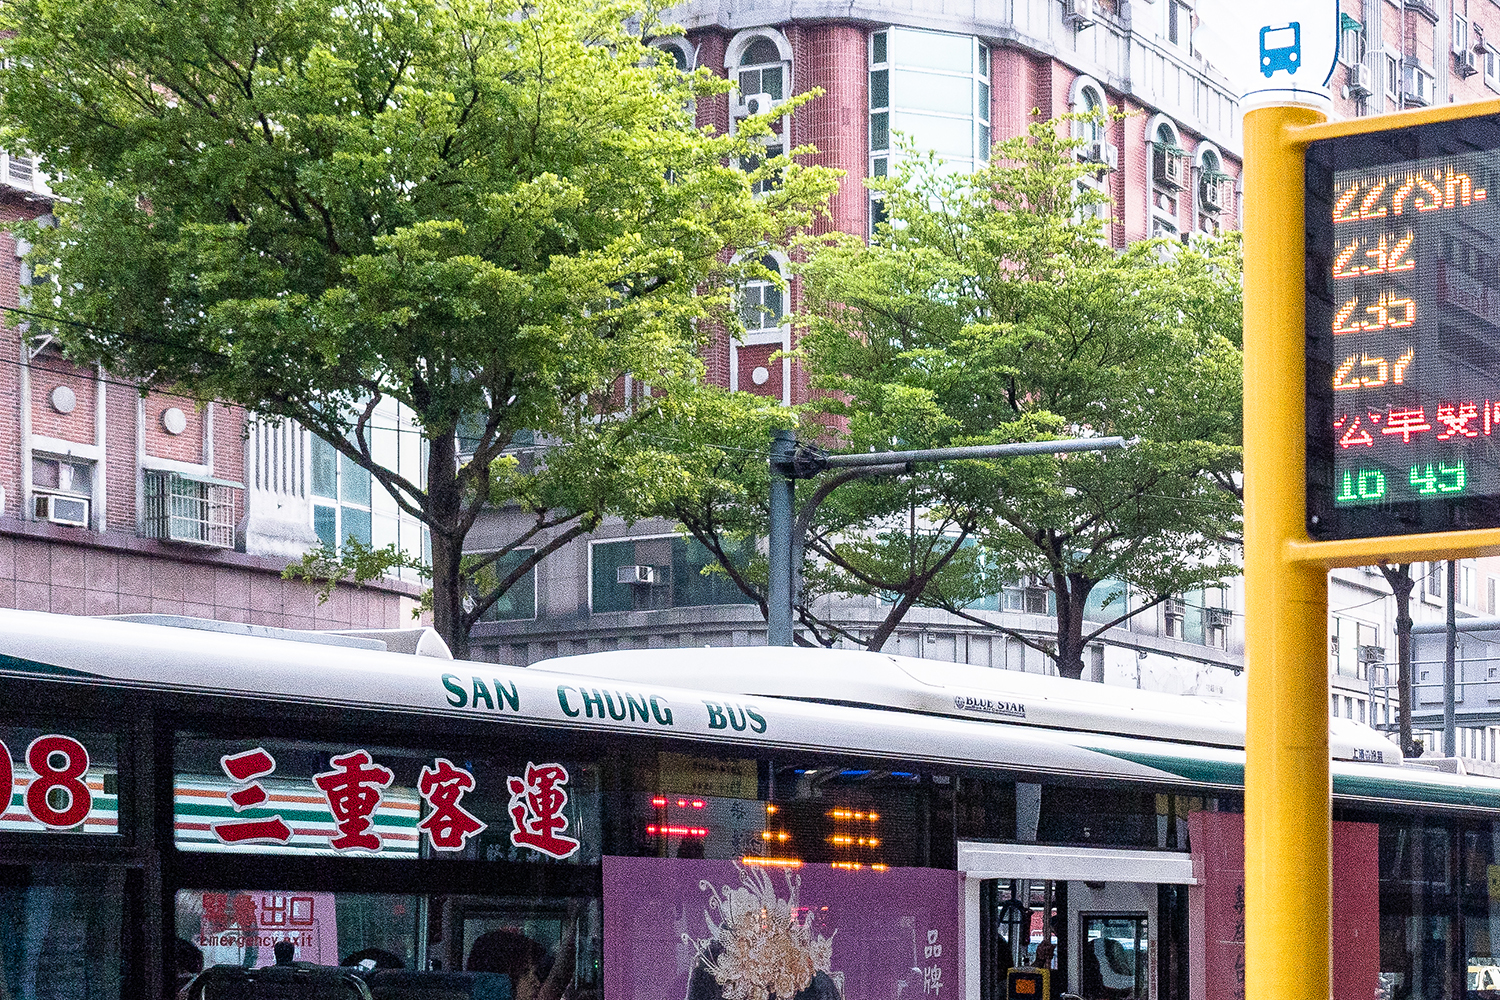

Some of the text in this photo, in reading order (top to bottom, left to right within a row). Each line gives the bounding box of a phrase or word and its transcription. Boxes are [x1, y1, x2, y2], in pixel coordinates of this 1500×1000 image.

[441, 673, 768, 734] SAN CHUNG BUS
[966, 696, 993, 709] BLUE
[211, 748, 580, 859] 三重客運
